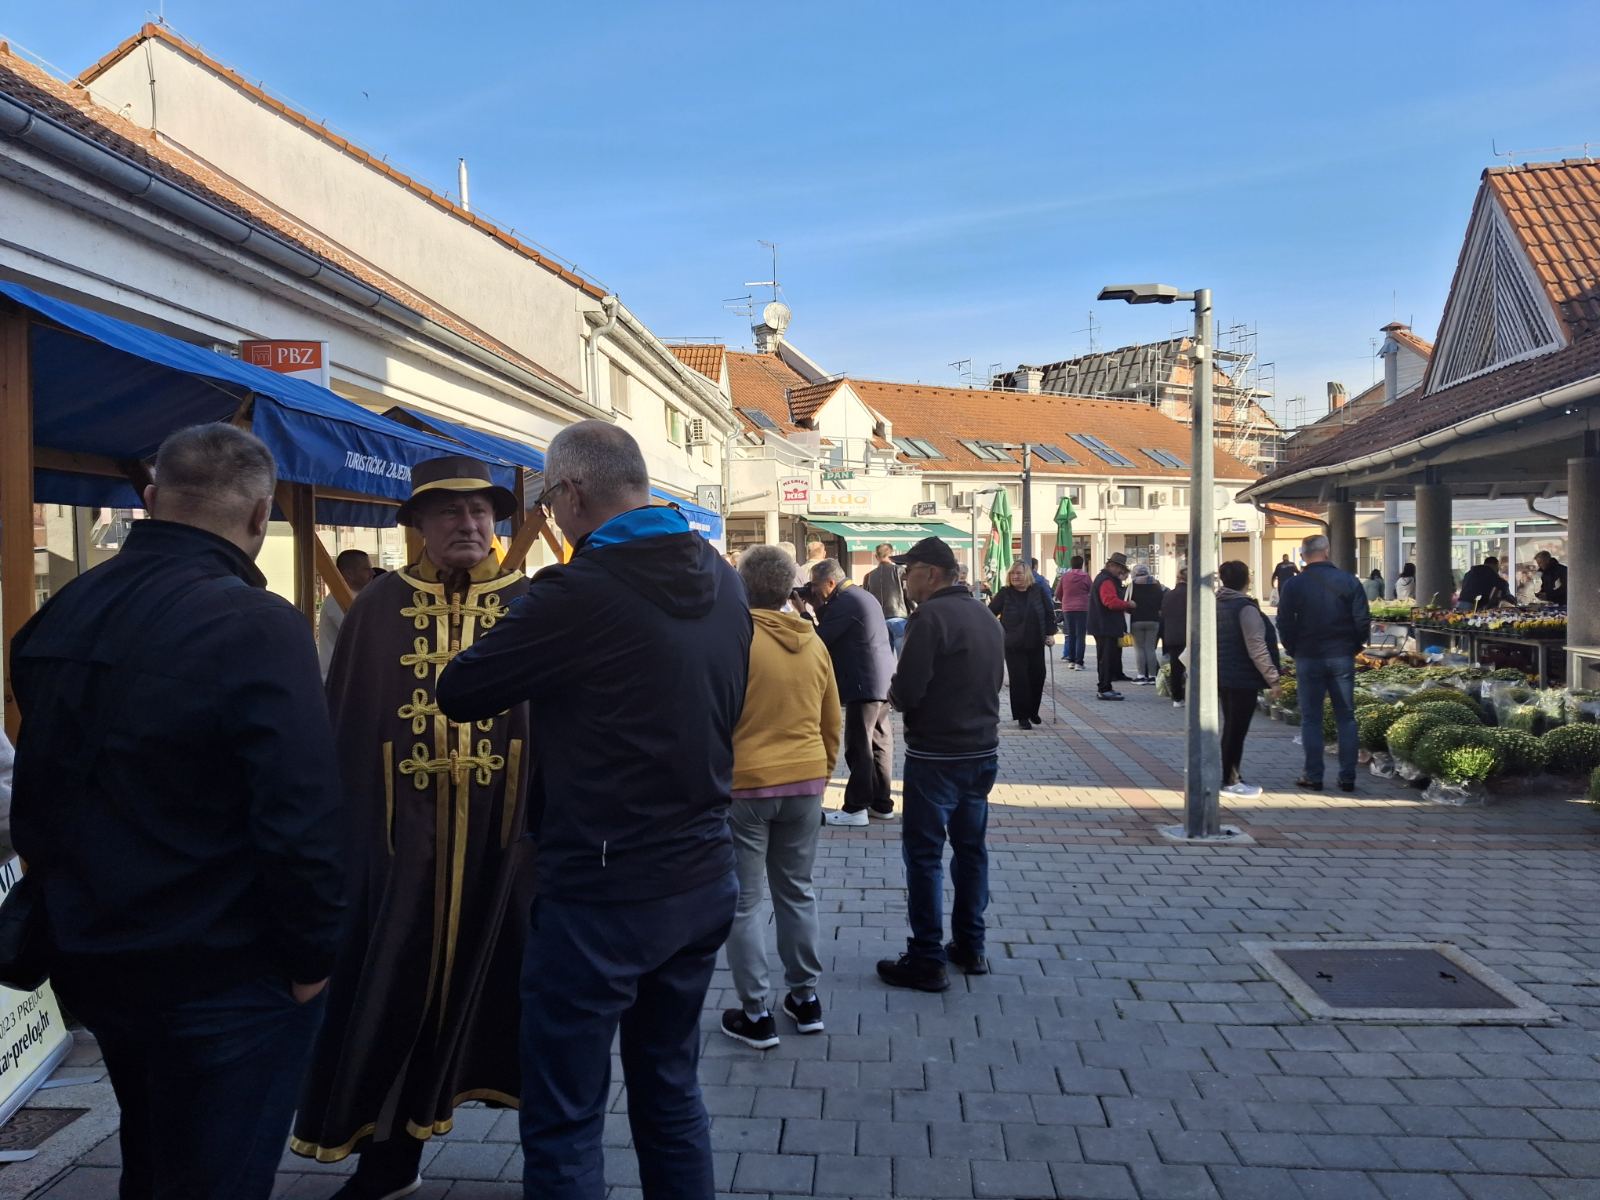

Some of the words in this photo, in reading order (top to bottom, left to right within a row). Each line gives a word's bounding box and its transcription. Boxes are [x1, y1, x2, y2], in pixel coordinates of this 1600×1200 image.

[277, 347, 314, 365] PBZ
[344, 450, 387, 476] TURISTIČKA
[827, 471, 849, 480] PAN
[815, 493, 867, 505] Lido
